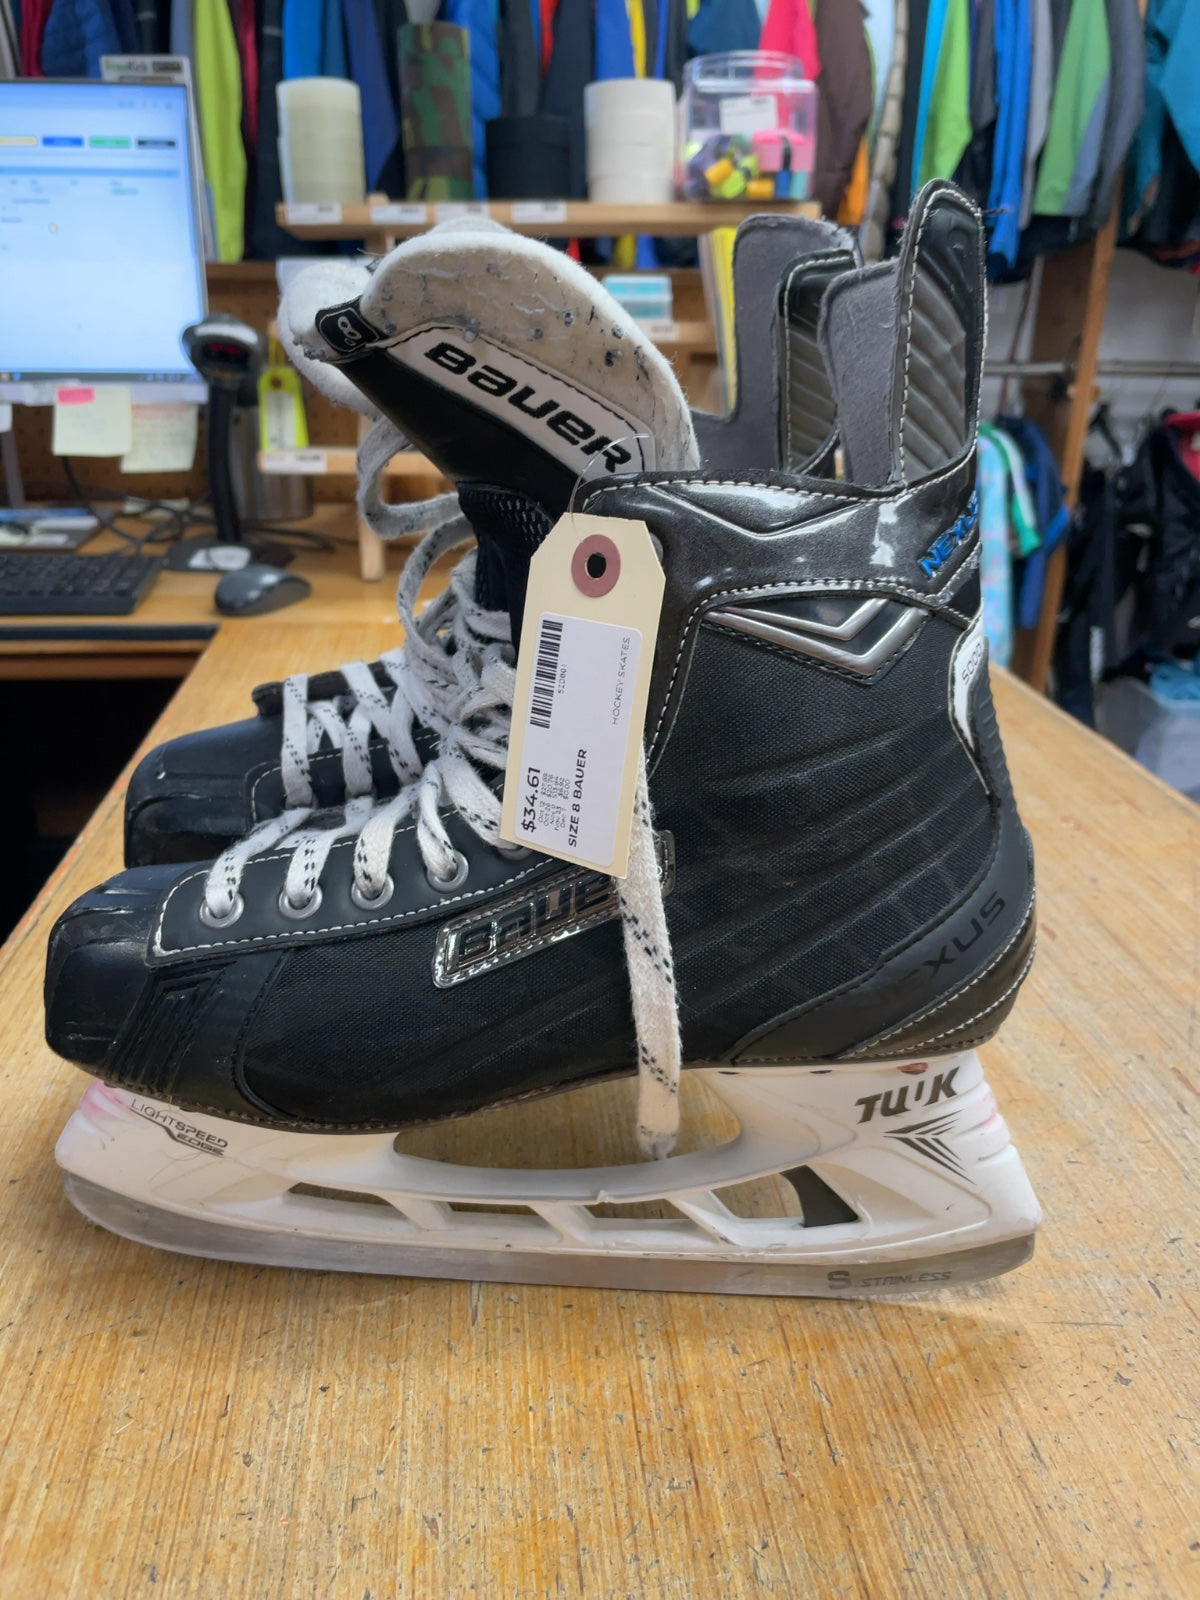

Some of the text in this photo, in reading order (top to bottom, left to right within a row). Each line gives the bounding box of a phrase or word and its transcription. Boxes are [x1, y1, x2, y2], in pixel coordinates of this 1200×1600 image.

[917, 489, 978, 578] NEXU
[612, 637, 630, 725] HOCKEY SKATES
[521, 767, 541, 832] $34.61
[568, 749, 588, 847] SIZE 8 BAUER
[130, 1098, 229, 1149] LIGHTSPEED
[176, 1132, 226, 1156] EDGE
